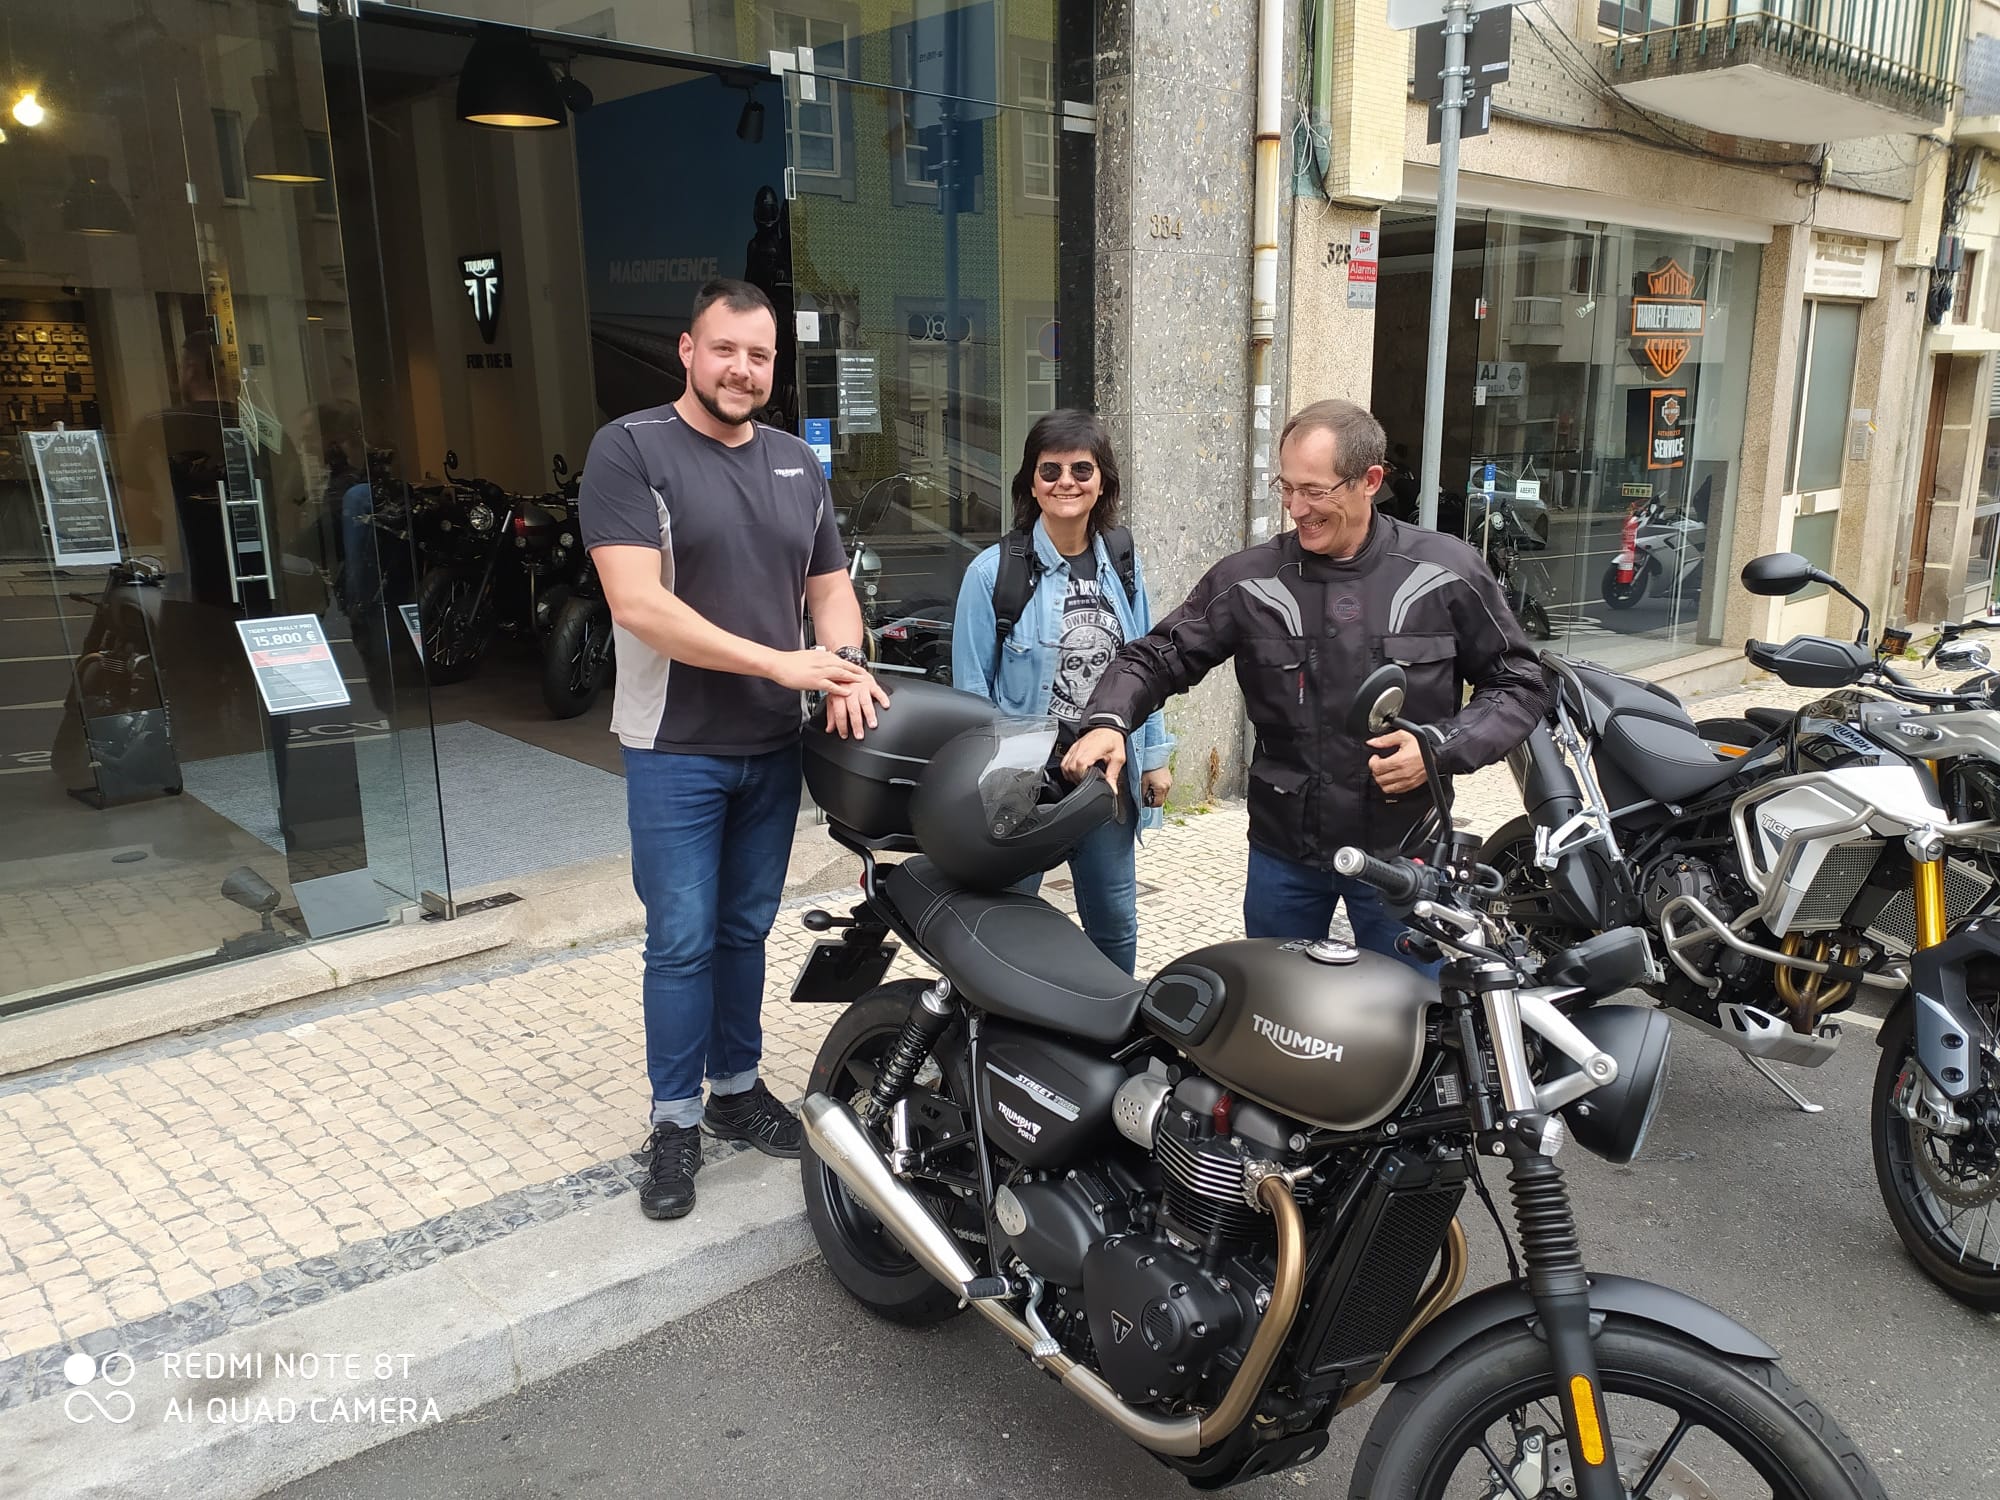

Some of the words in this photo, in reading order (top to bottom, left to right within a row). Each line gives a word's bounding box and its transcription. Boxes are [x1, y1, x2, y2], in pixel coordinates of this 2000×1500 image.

[1150, 214, 1183, 240] 334
[1327, 243, 1352, 264] 328
[1350, 262, 1376, 275] Alarme
[1637, 304, 1702, 329] HARLEY-DAVIDSON
[1650, 338, 1687, 371] CYCLES
[1654, 437, 1685, 459] SERVICE
[1065, 612, 1108, 630] OWNERS
[252, 632, 302, 647] 15.800
[306, 630, 317, 641] €
[1825, 722, 1873, 752] TRIUMPH
[1762, 814, 1793, 839] TIGE
[1252, 1013, 1344, 1062] TRIUMPH
[1015, 1073, 1055, 1099] STREET
[998, 1101, 1033, 1131] TRIUMPH
[1017, 1127, 1037, 1143] PORTO
